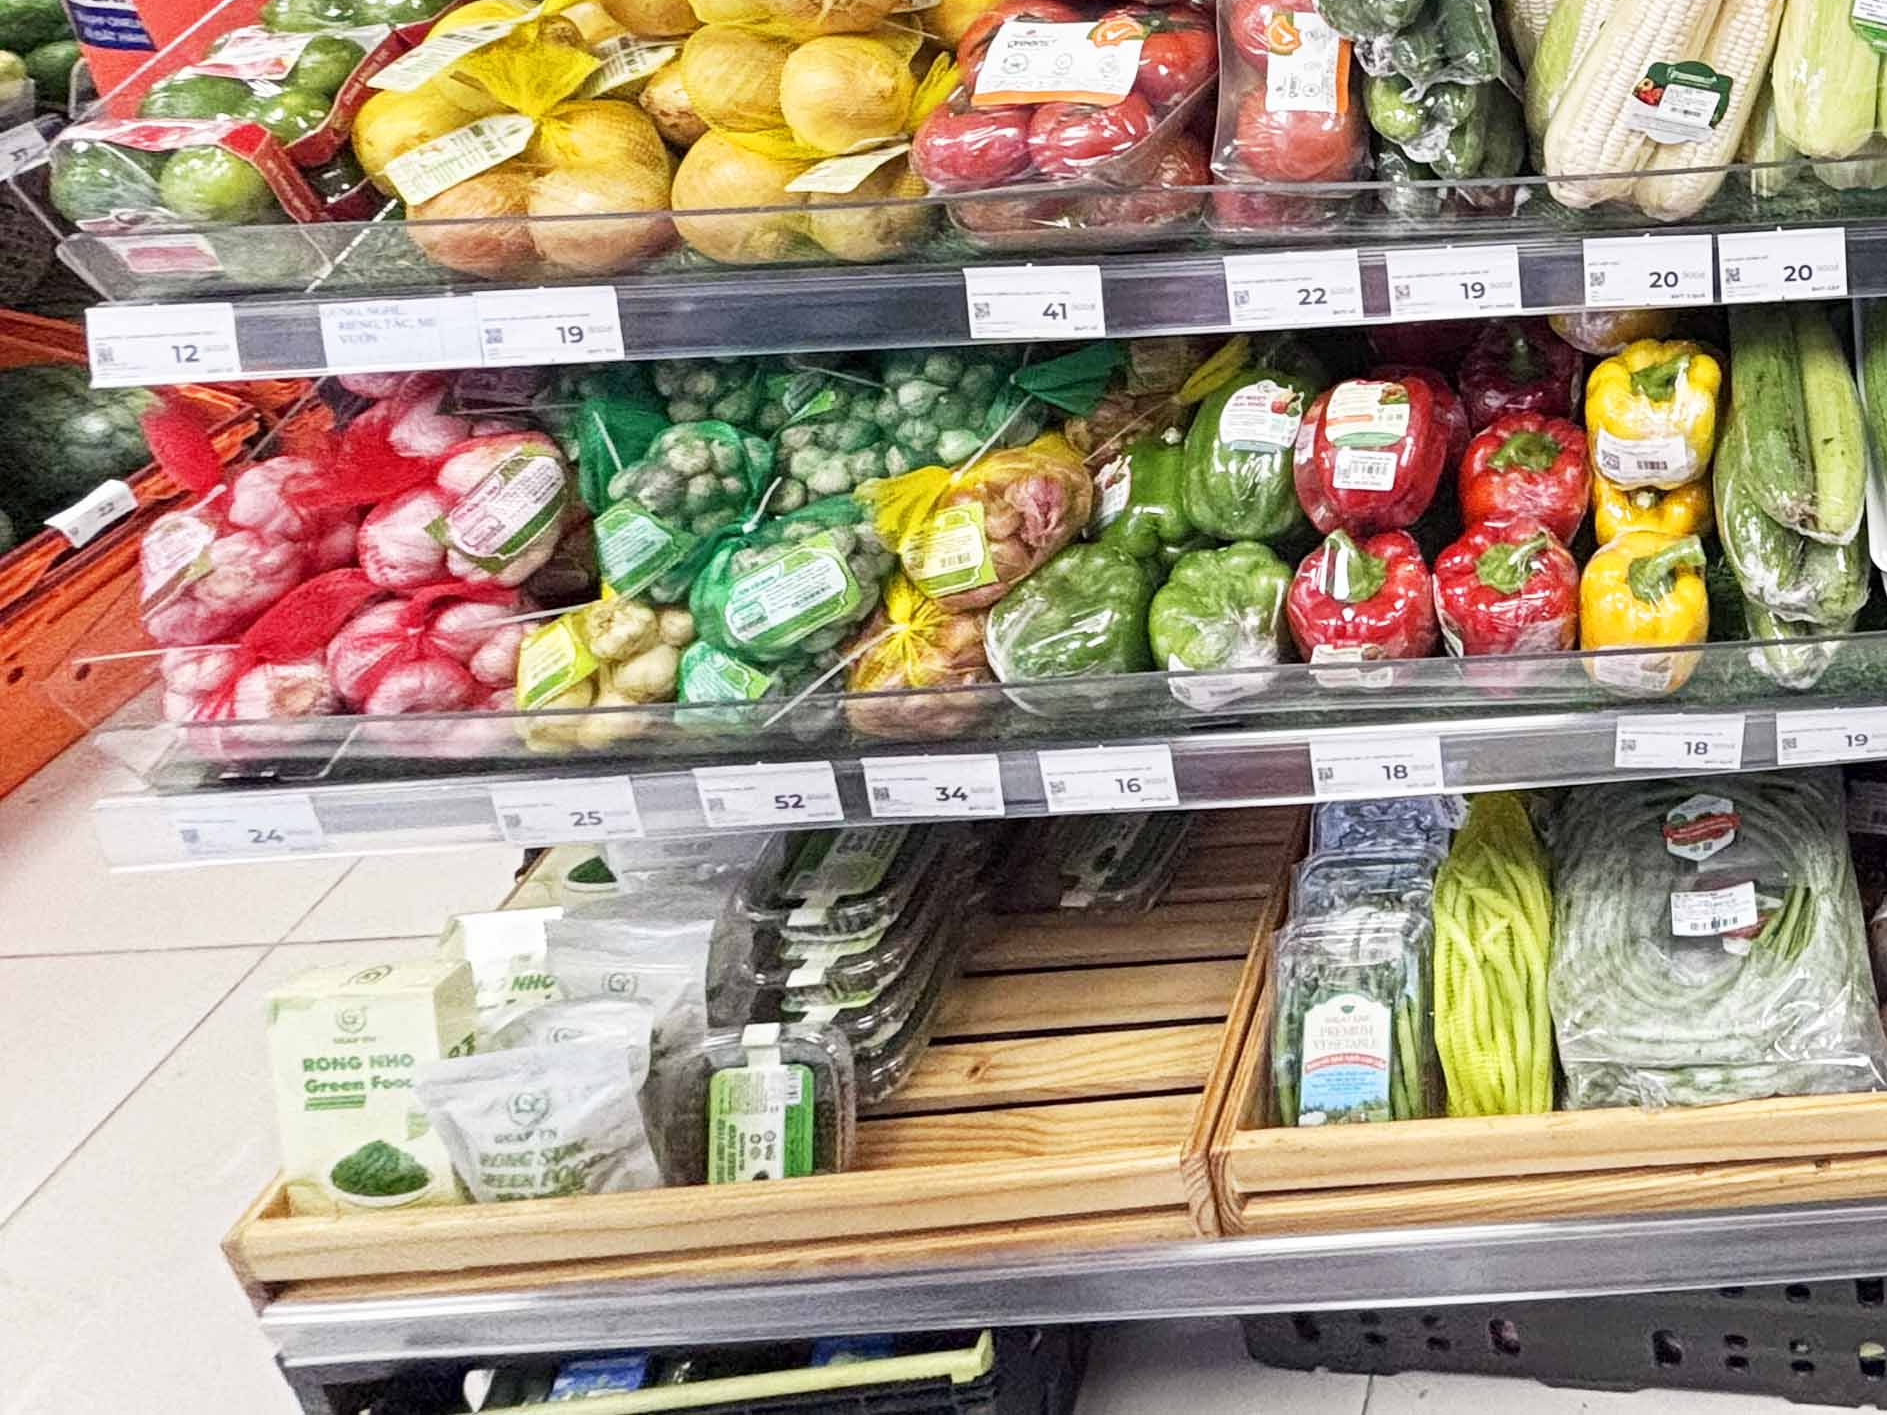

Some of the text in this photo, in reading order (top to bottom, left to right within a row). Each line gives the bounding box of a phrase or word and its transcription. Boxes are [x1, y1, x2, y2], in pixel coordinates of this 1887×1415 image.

[1648, 270, 1679, 289] 20
[1783, 264, 1813, 283] 20
[1297, 287, 1328, 306] 22
[1459, 281, 1486, 300] 19
[1042, 302, 1068, 321] 41
[556, 325, 585, 344] 19
[171, 344, 201, 364] 12
[1683, 740, 1709, 756] 18
[1844, 733, 1869, 748] 19
[1381, 764, 1409, 781] 18
[934, 786, 969, 802] 34
[1114, 777, 1142, 794] 16
[774, 793, 807, 811] 52
[568, 810, 604, 827] 25
[247, 828, 285, 845] 24
[302, 1052, 416, 1073] RONG NHO
[303, 1078, 365, 1094] Green
